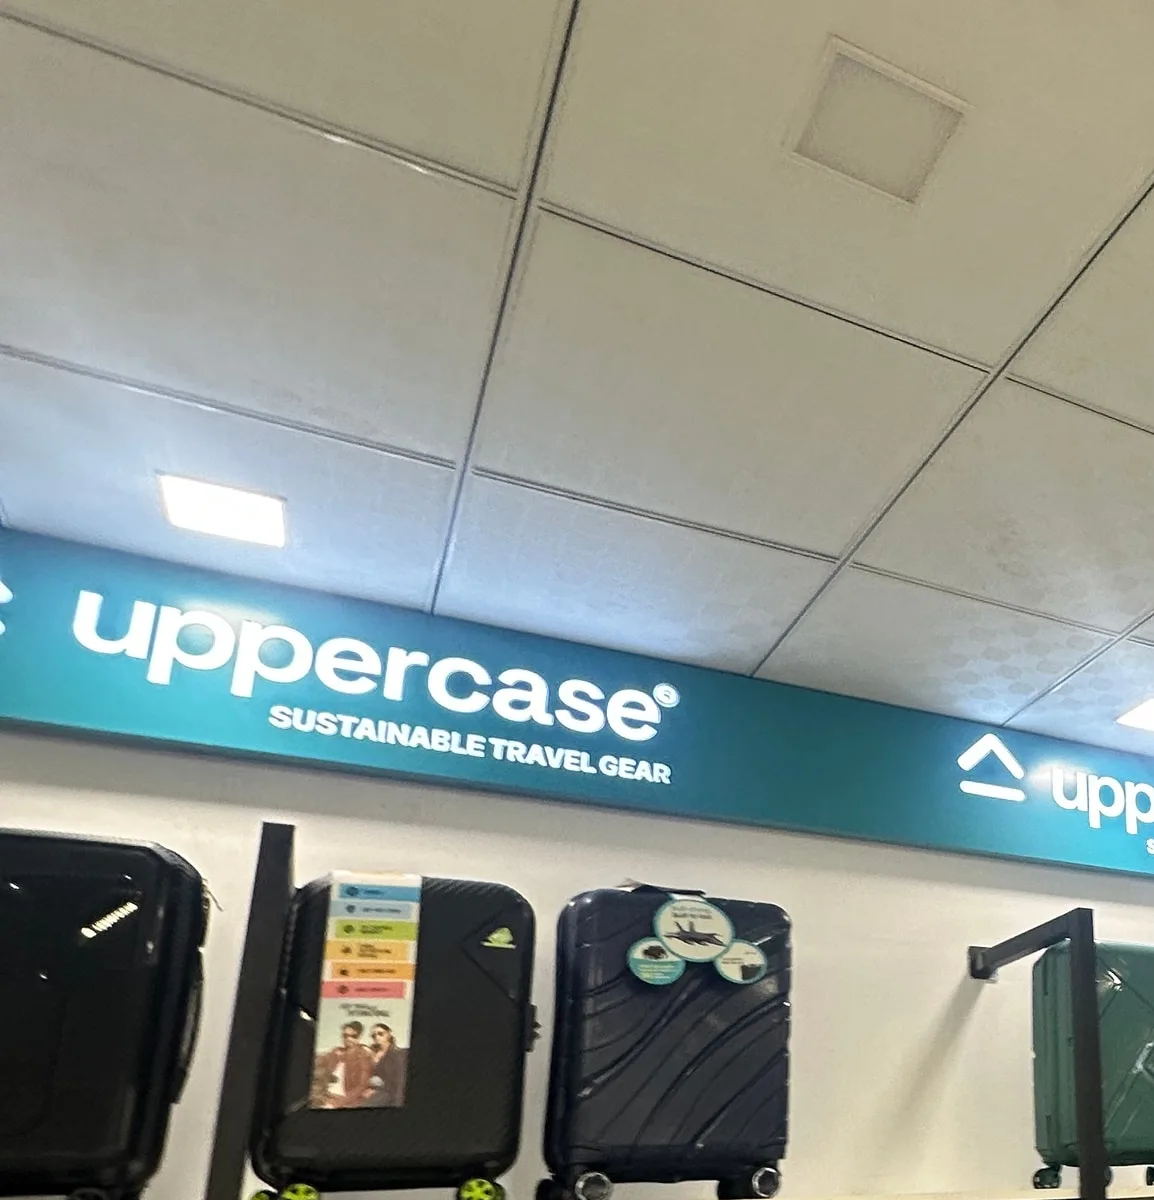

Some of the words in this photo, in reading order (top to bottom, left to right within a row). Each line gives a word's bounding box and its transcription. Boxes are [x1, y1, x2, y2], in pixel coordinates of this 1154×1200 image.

[268, 704, 486, 758] SUSTAINABLE
[488, 737, 598, 774] TRAVEL
[599, 755, 672, 785] GEAR
